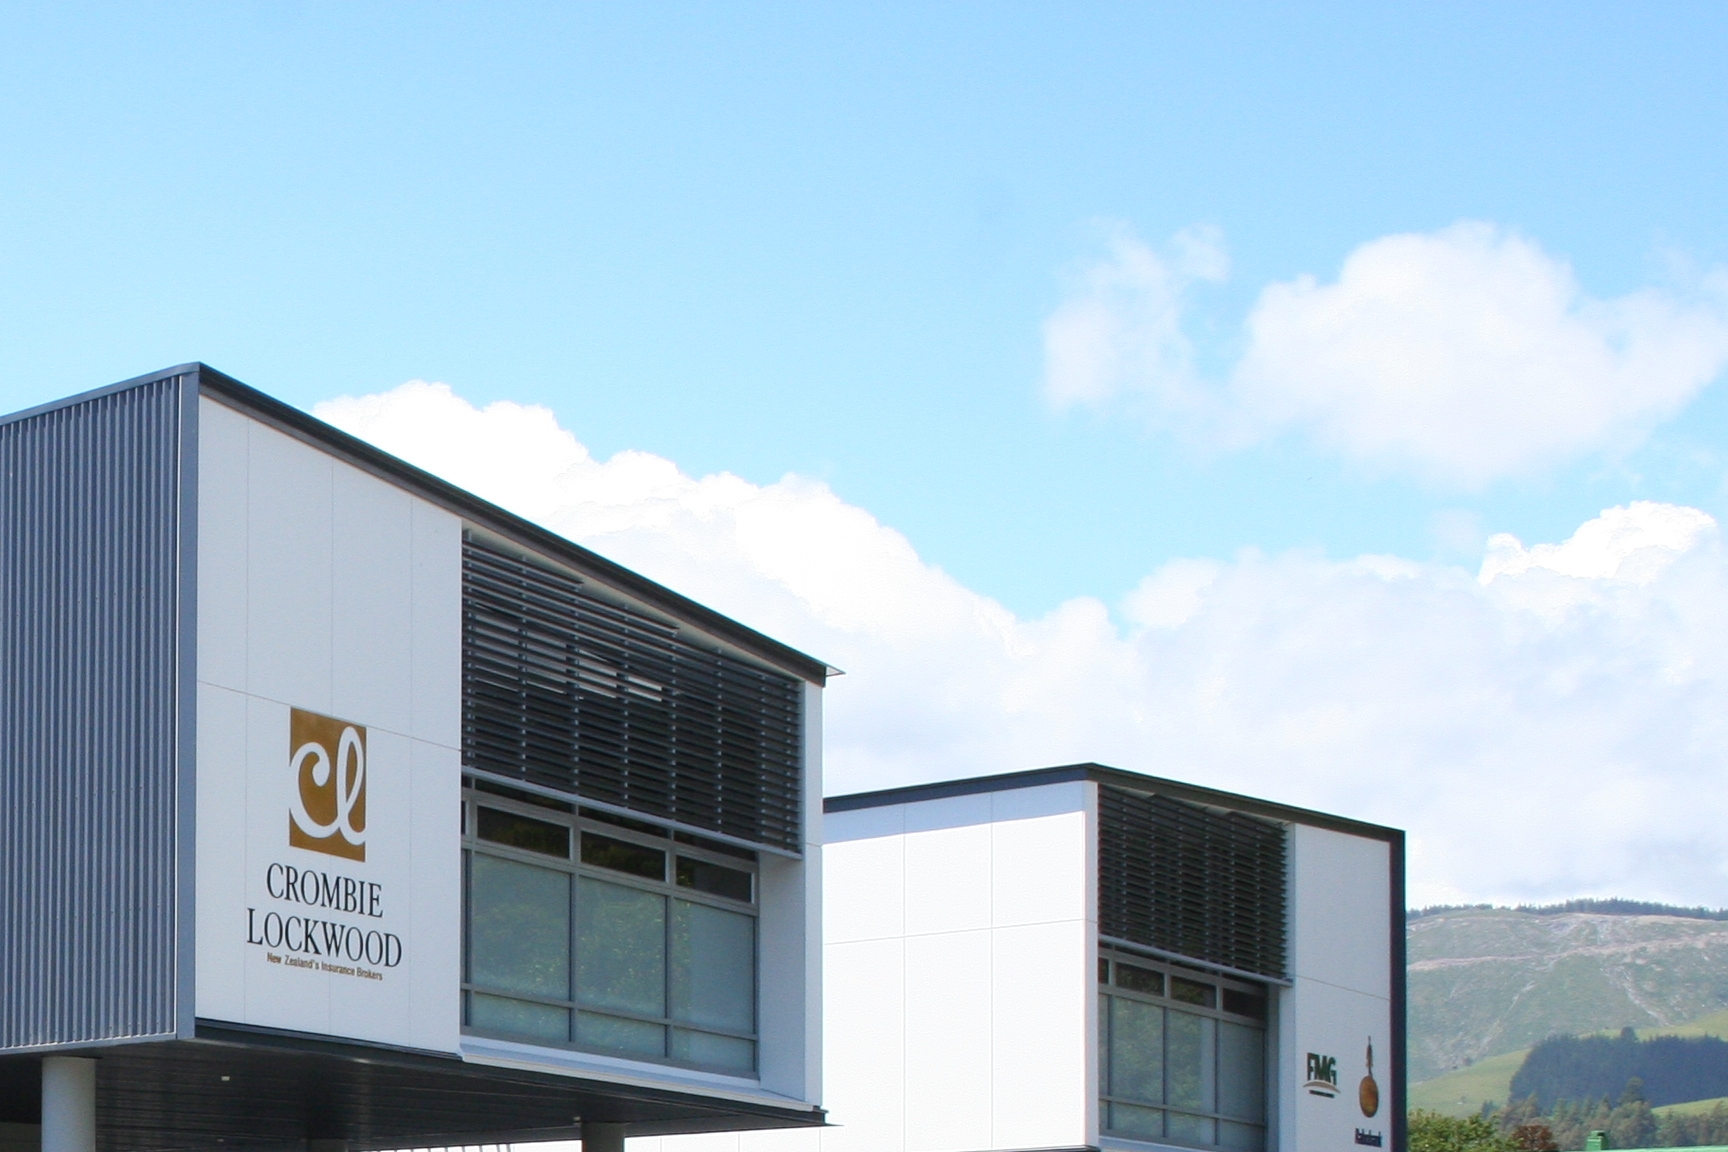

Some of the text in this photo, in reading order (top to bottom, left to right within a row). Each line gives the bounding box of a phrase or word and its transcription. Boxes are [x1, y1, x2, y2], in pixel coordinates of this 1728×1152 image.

[266, 862, 384, 918] CROMBIE
[246, 907, 402, 967] LOCKWOOD
[267, 952, 383, 981] New Zealand's Insurance Brokers
[1307, 1052, 1337, 1086] FMG
